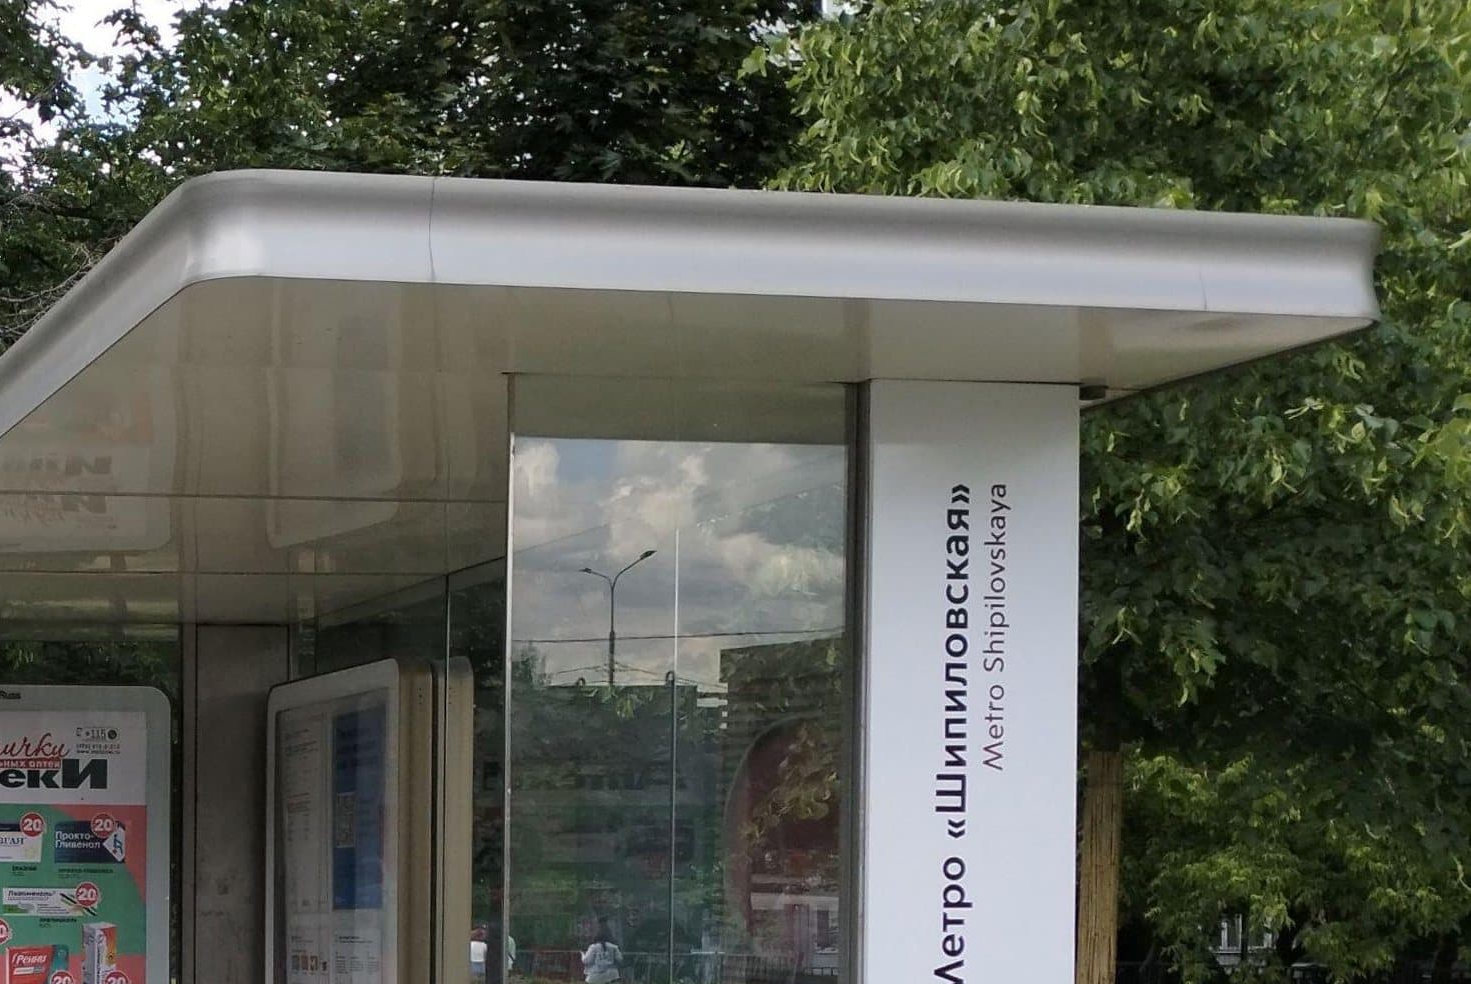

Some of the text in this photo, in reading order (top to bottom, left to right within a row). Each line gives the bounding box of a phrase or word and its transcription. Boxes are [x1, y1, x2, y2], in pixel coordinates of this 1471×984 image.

[935, 483, 972, 840] «Шипиловская»
[982, 482, 1013, 771] Metro Shipilovskaya
